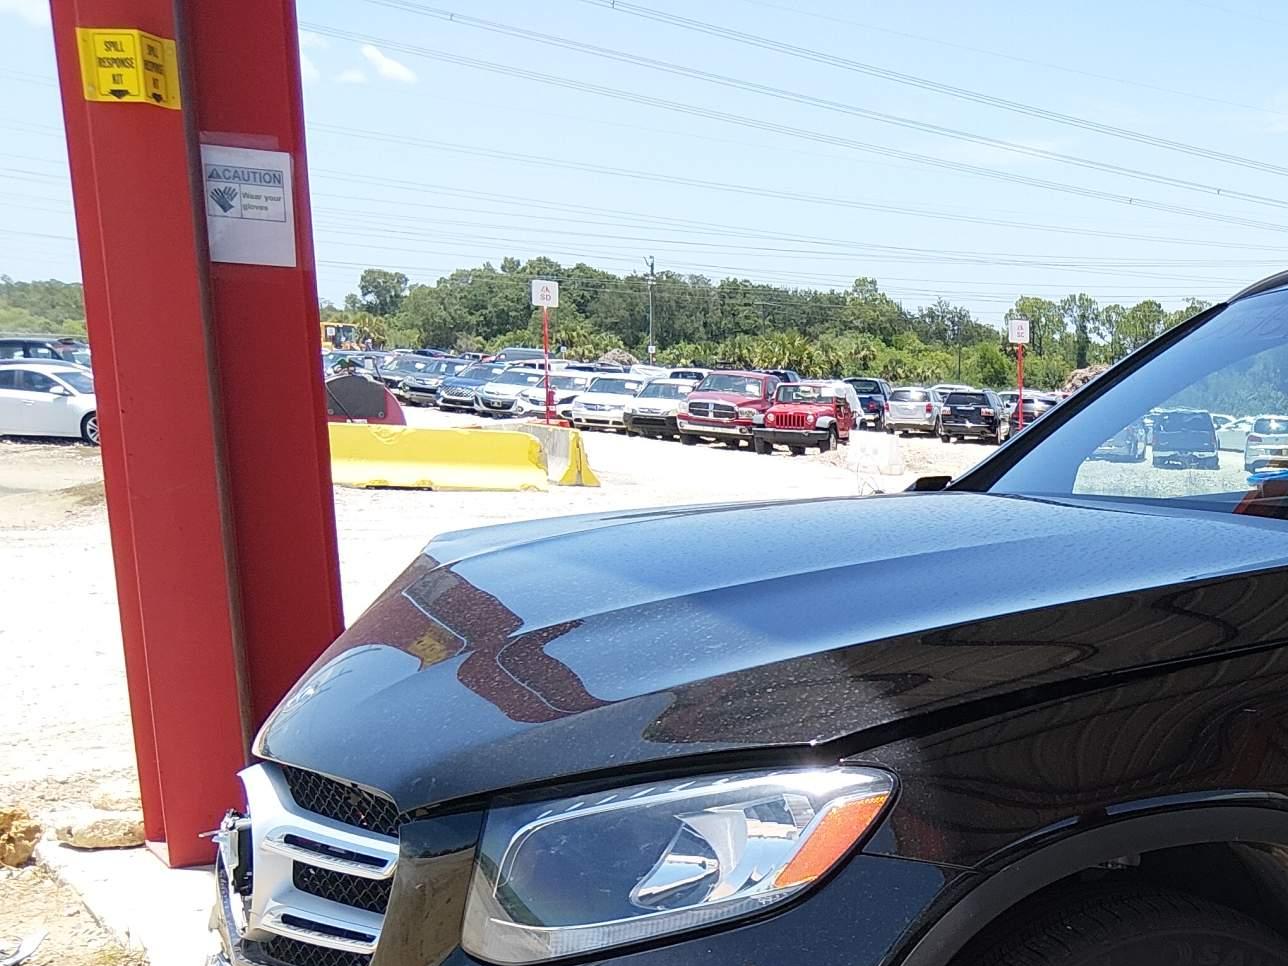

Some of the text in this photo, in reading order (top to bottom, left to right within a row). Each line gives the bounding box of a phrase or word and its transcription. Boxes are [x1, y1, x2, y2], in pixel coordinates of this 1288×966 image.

[222, 168, 282, 185] CAUTION
[242, 192, 282, 203] Wear your
[242, 203, 269, 212] gloves
